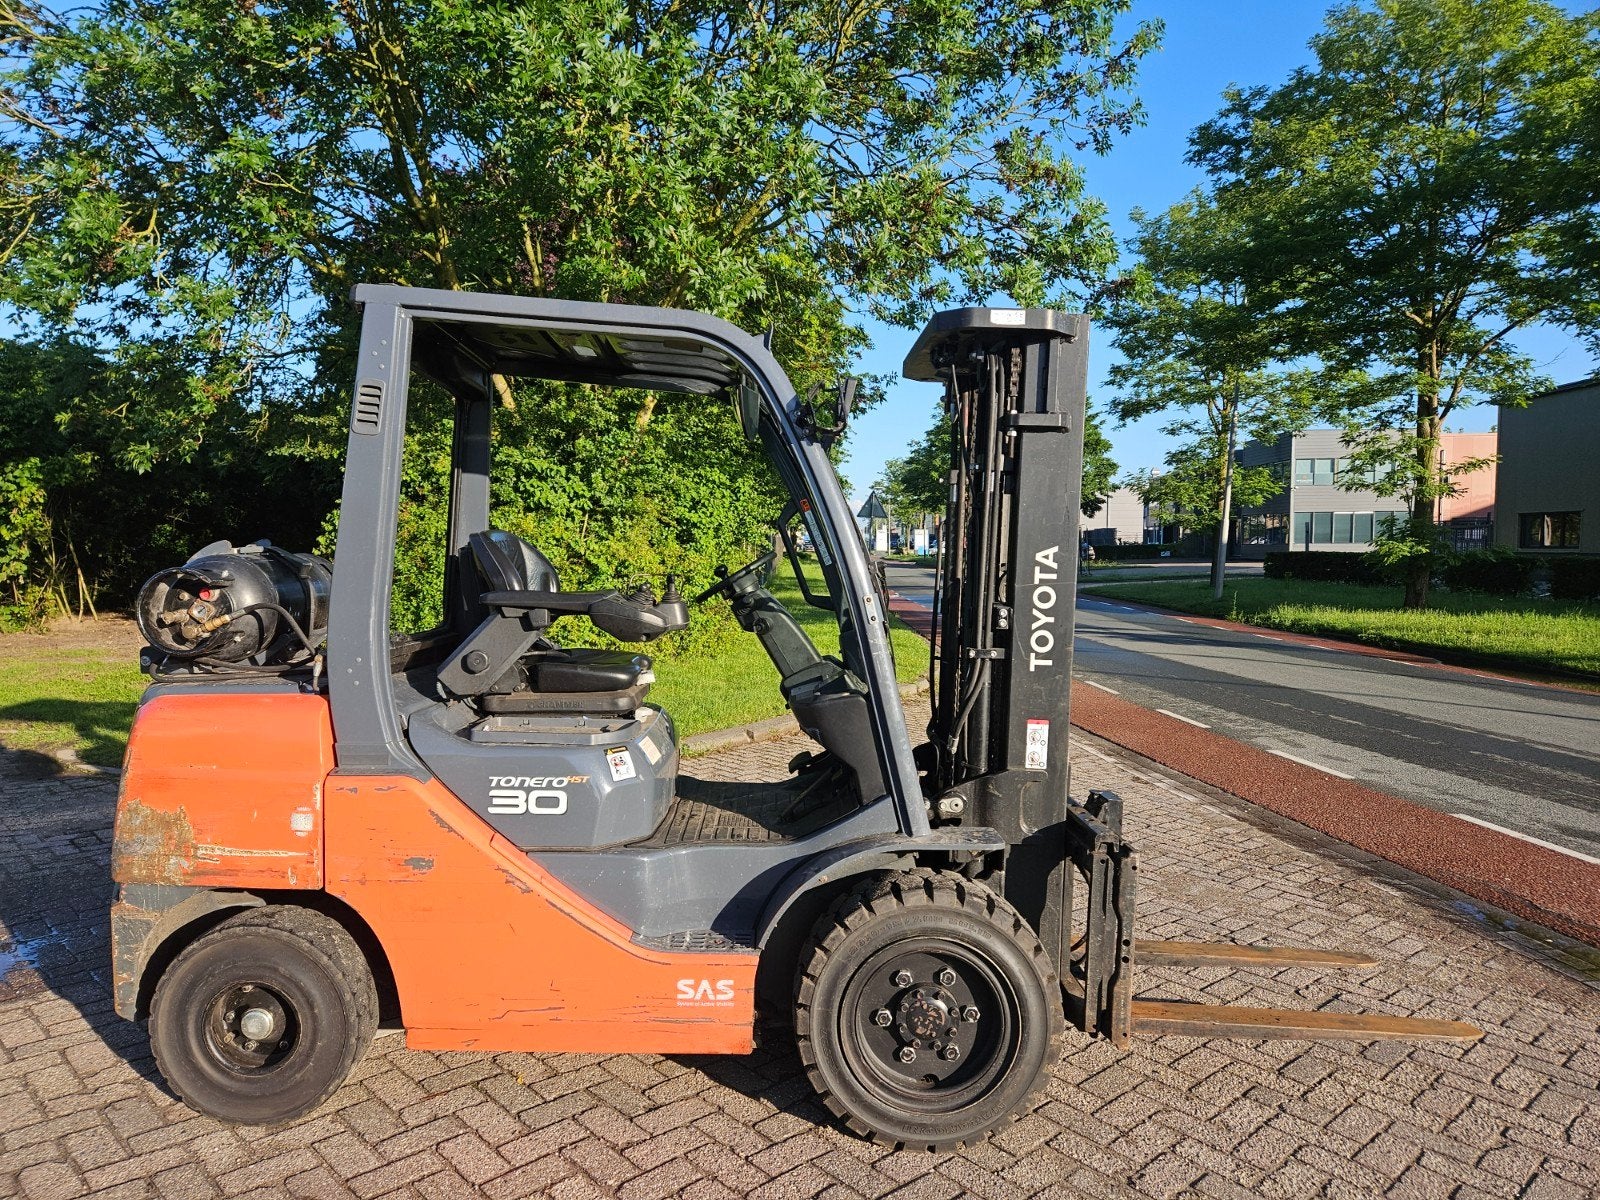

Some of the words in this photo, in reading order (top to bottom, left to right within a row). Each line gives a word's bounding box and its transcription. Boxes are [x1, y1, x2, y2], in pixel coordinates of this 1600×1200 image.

[1029, 545, 1059, 672] TOYOTA
[487, 789, 568, 815] 30
[676, 979, 735, 1000] SAS
